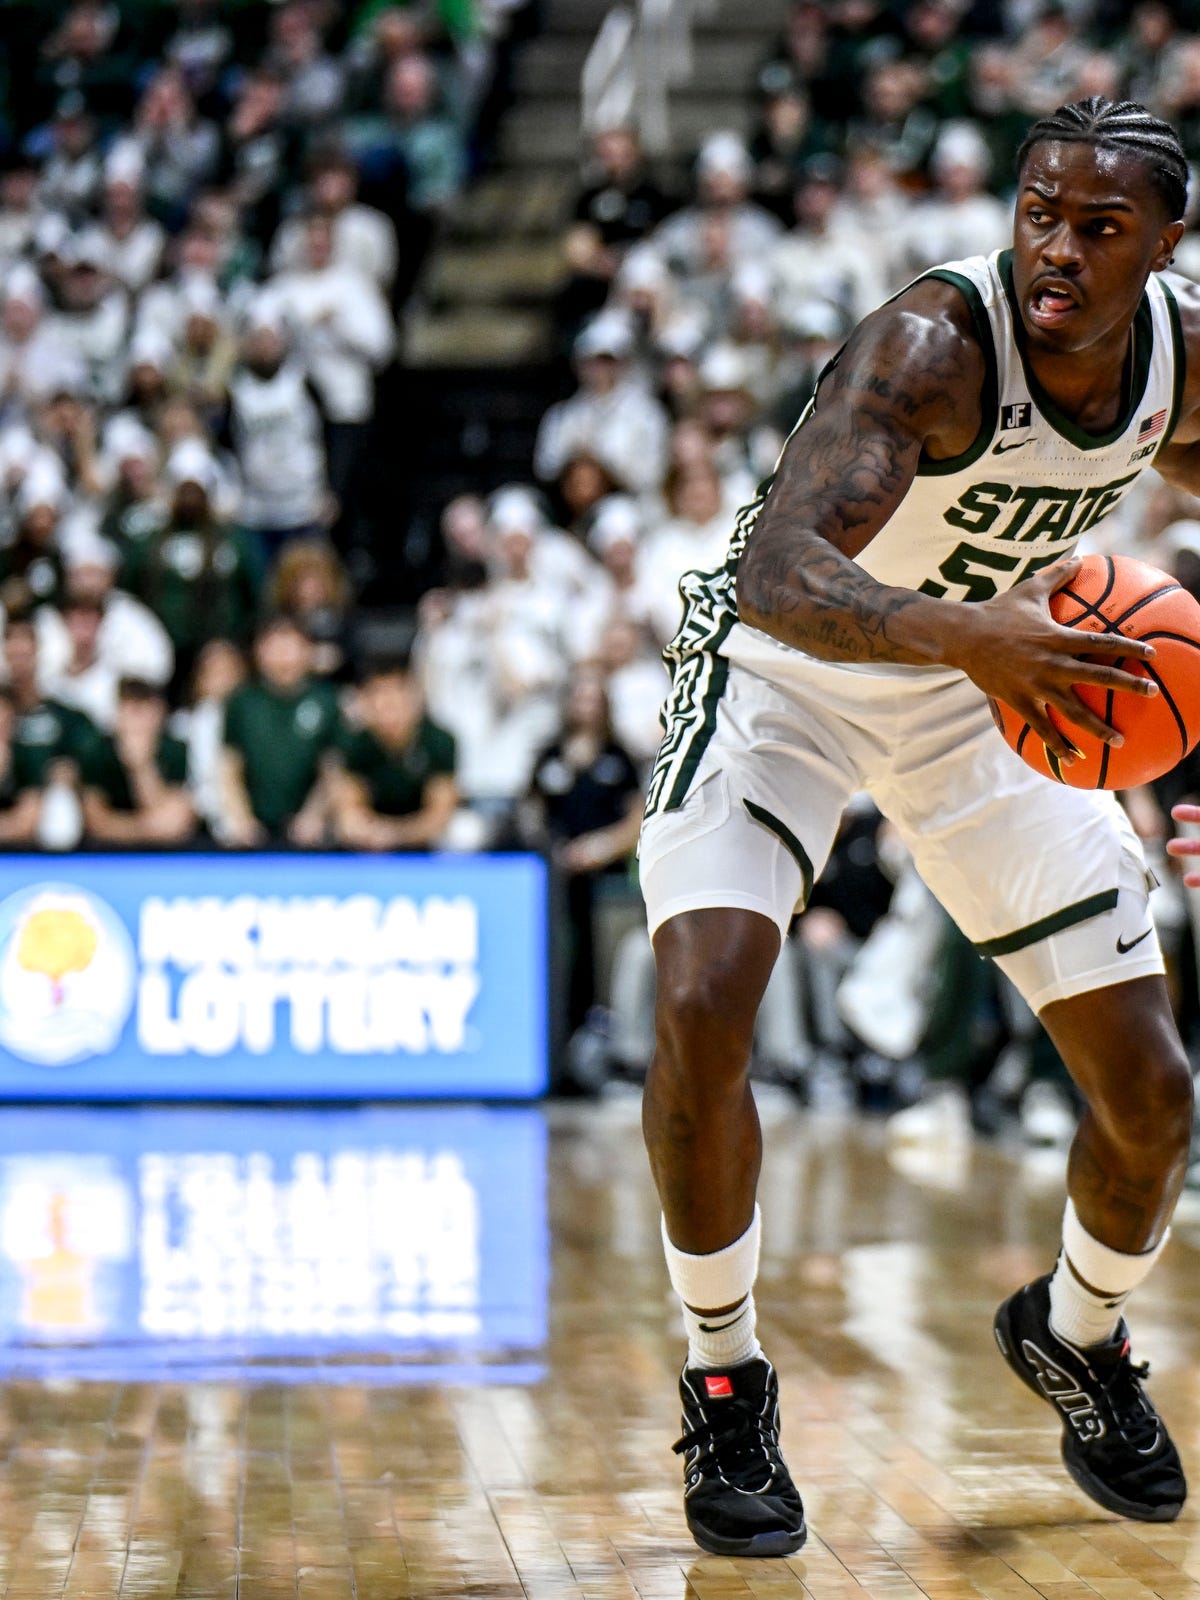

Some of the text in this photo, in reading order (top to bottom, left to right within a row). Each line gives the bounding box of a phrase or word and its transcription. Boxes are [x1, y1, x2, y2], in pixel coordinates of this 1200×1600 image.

[1007, 404, 1025, 428] JF
[943, 469, 1142, 542] STATE
[917, 541, 1076, 602] 5
[139, 895, 478, 965] MICHIGAN
[138, 972, 481, 1055] LOTTERY
